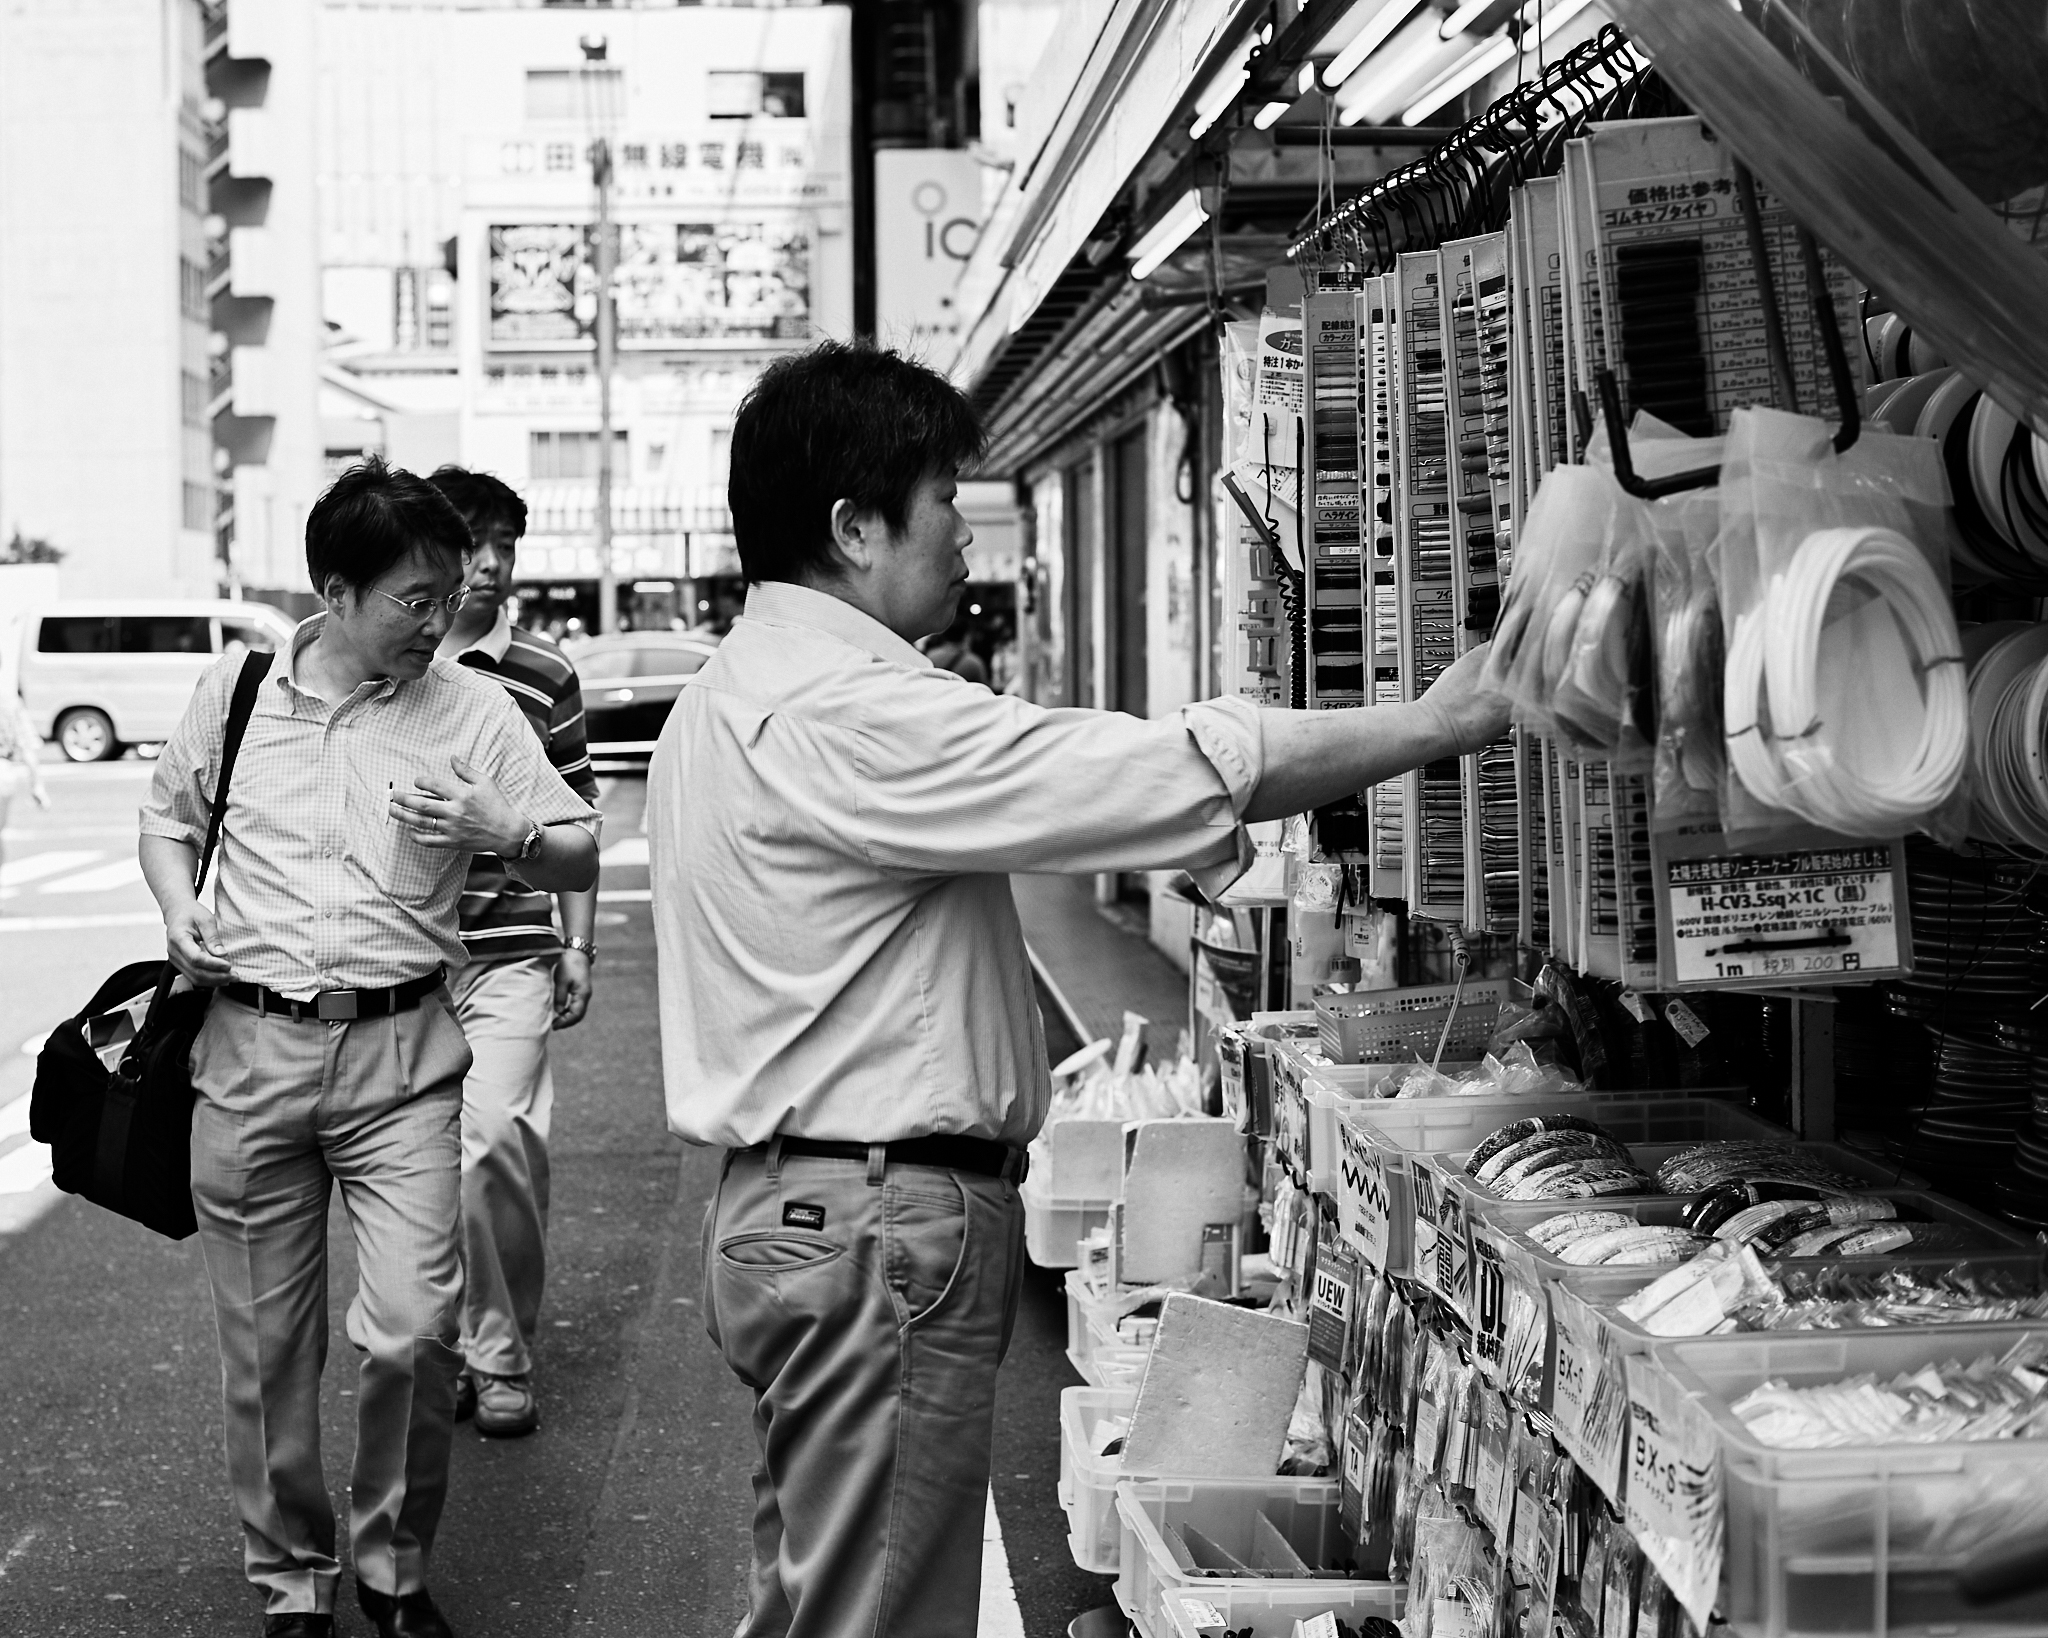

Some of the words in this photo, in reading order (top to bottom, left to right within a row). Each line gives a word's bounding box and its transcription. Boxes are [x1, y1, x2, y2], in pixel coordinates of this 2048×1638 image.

[1628, 178, 1741, 205] 価格は参考
[1803, 955, 1834, 971] 200
[1843, 952, 1860, 971] 円
[1317, 1275, 1346, 1309] UEW
[1559, 1348, 1583, 1394] BX-S
[1635, 1434, 1676, 1494] BX-S
